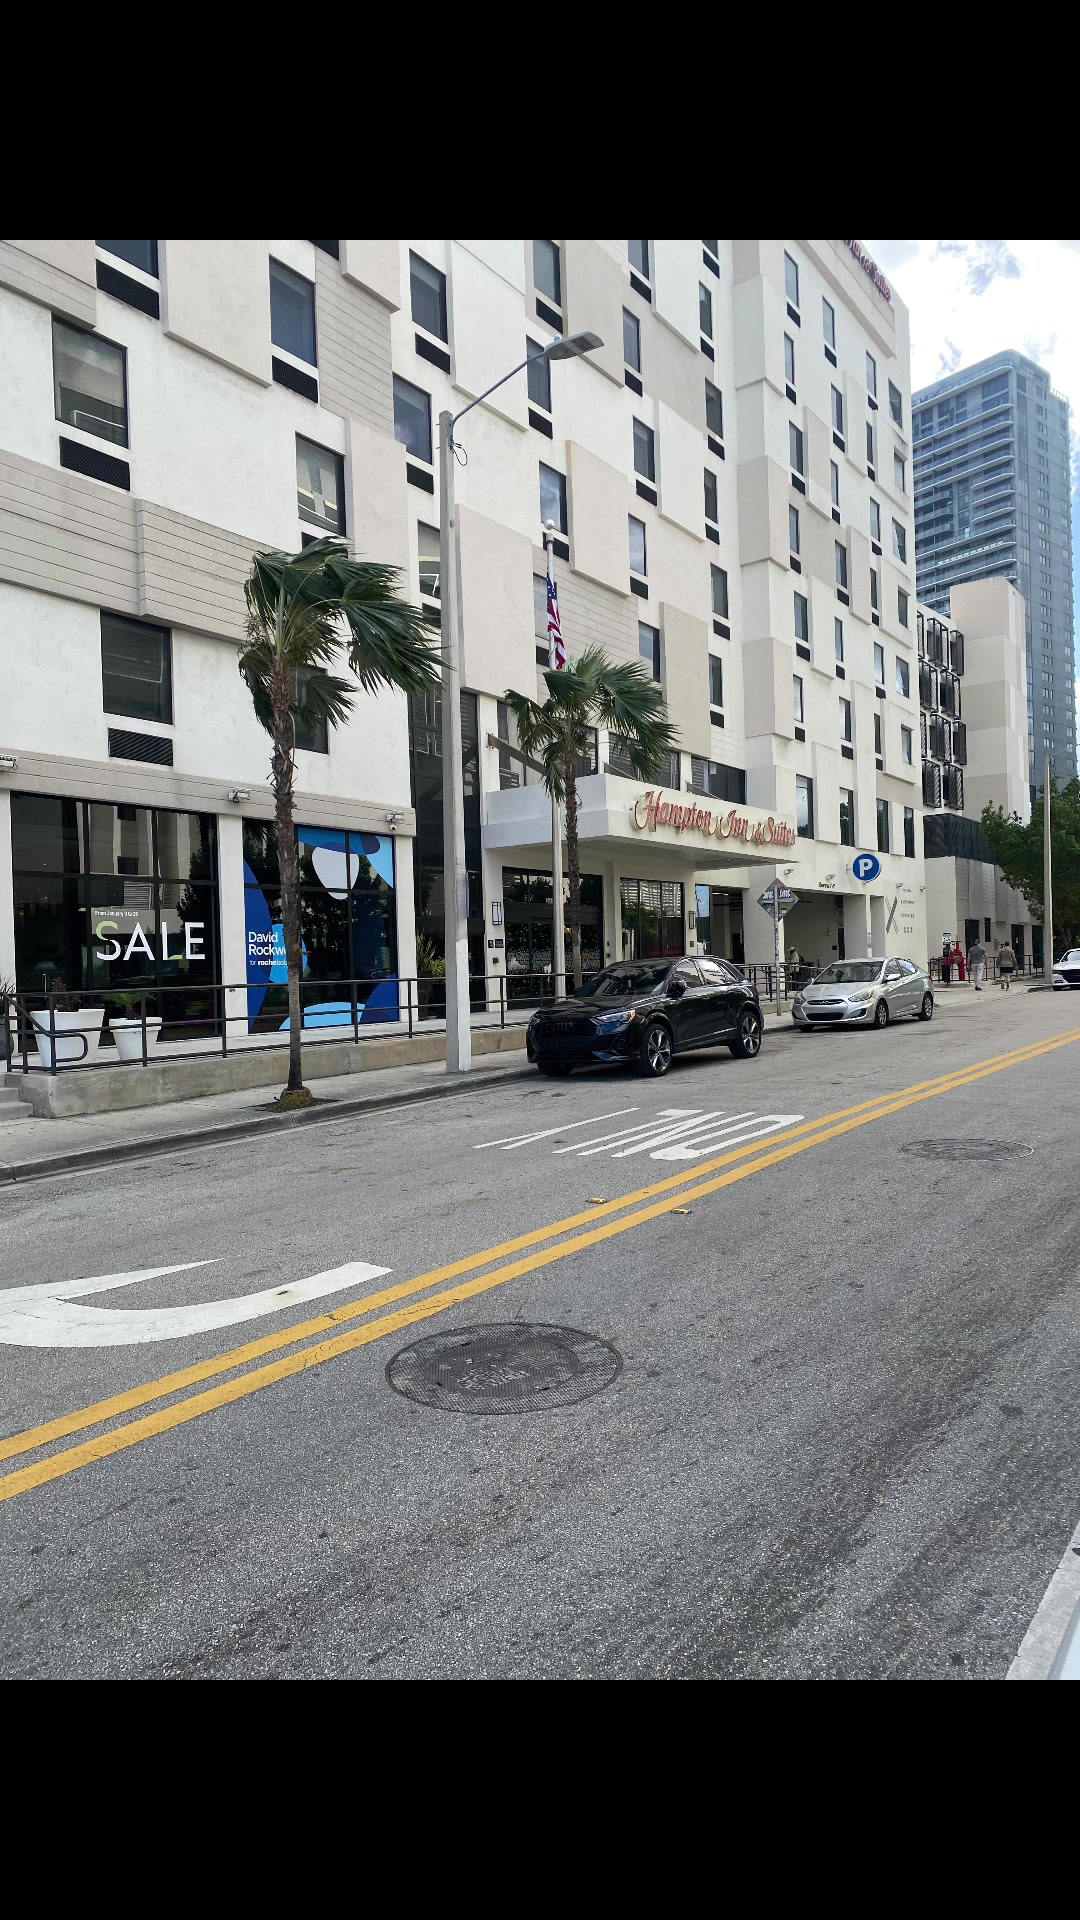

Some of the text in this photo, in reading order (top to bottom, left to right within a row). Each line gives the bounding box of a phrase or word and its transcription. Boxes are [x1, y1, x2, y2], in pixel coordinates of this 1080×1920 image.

[629, 790, 717, 836] Hampton
[715, 809, 755, 842] Inn
[762, 816, 796, 847] Suites
[859, 858, 873, 878] P
[95, 920, 206, 961] SALE
[248, 931, 279, 943] David
[248, 943, 287, 956] Rockw
